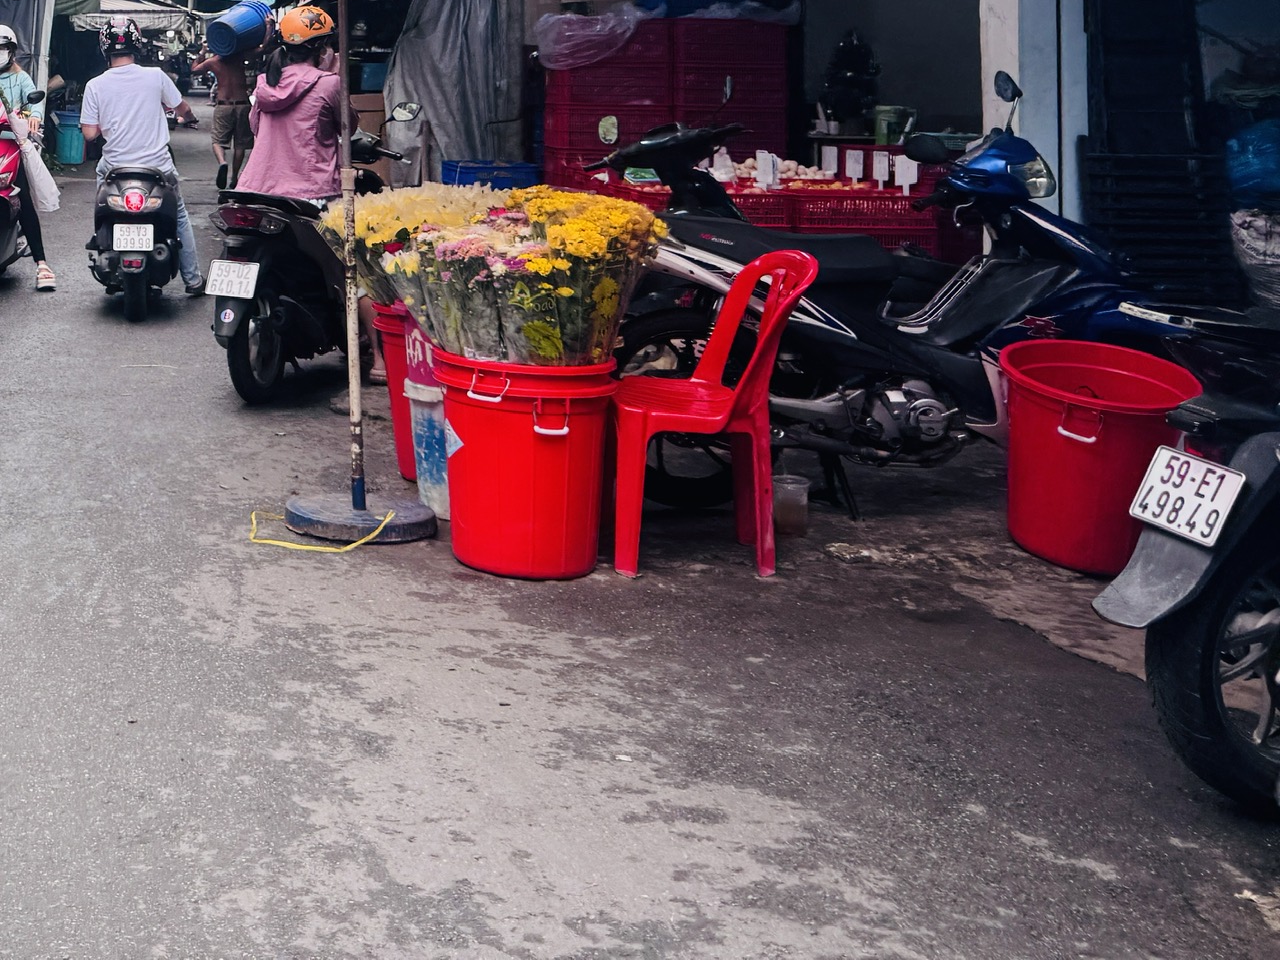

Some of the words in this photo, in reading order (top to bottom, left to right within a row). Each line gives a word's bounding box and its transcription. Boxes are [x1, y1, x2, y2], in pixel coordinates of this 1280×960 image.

[119, 226, 147, 237] 59-V3
[210, 279, 251, 296] 640.14
[1160, 454, 1227, 503] 59-E1
[1138, 485, 1220, 539] 498.49
